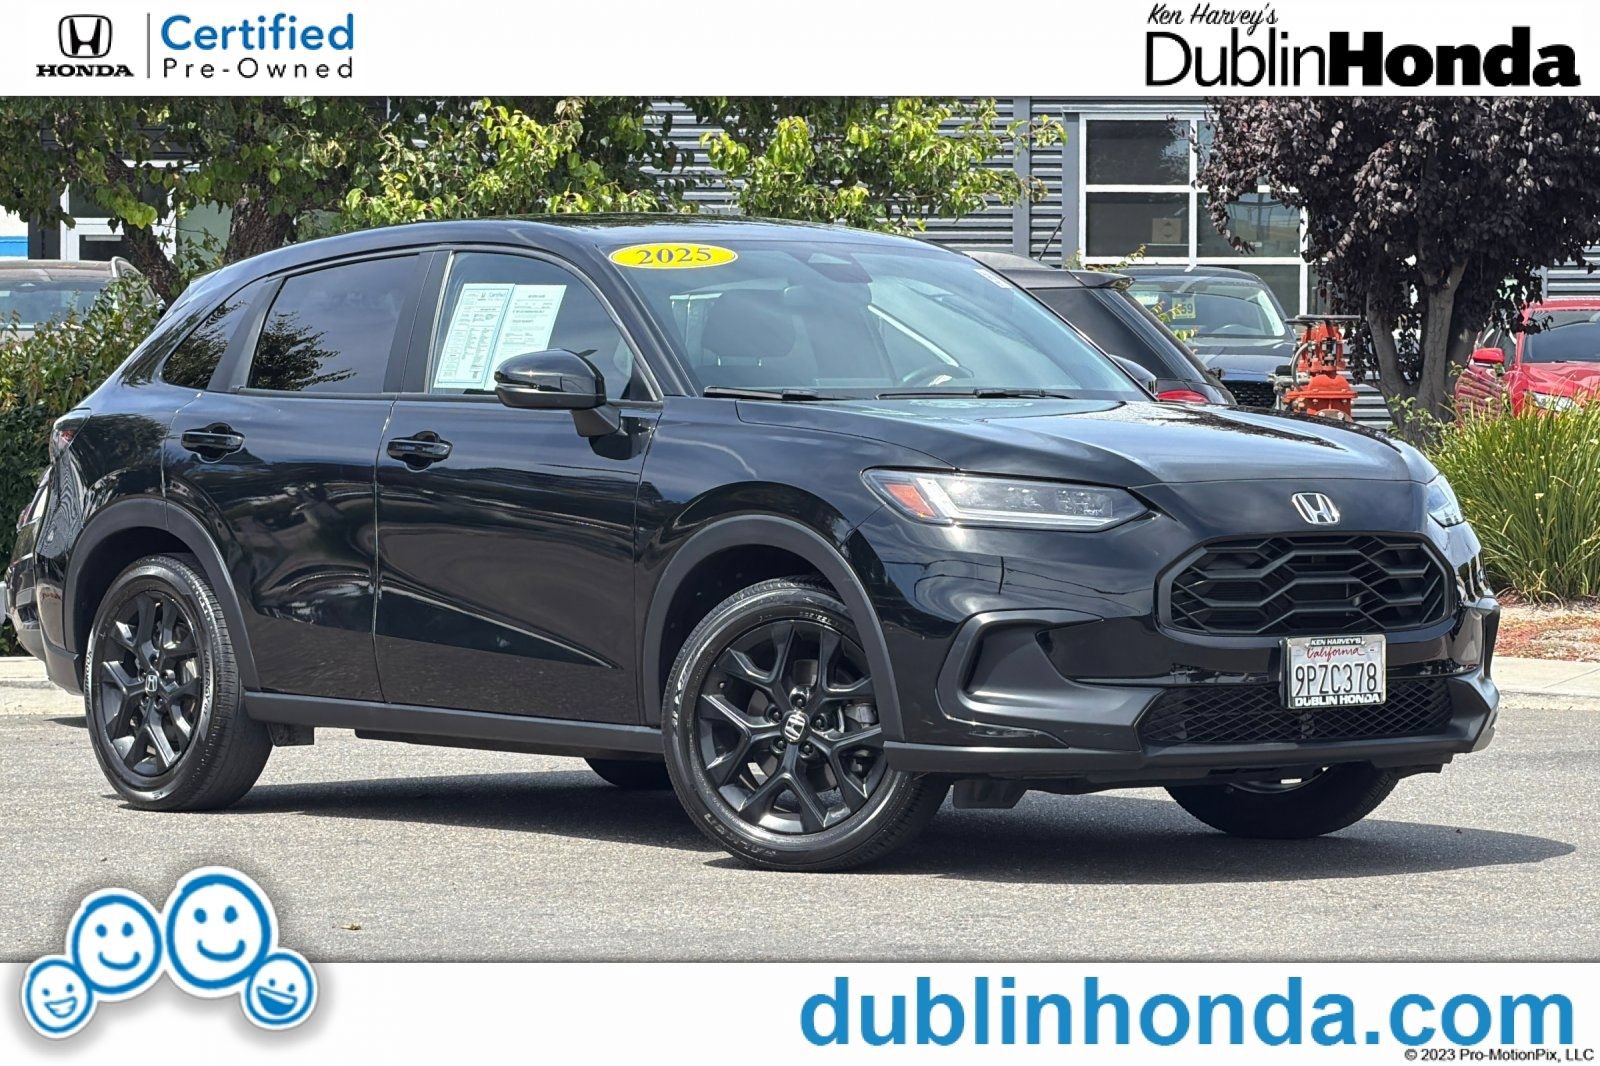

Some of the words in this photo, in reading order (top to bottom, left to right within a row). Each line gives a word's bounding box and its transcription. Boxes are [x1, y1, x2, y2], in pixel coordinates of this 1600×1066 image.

[635, 247, 712, 265] 2025
[1326, 637, 1361, 646] HARVEY'S
[1307, 646, 1366, 662] California
[1295, 662, 1378, 696] 9PZC378
[1294, 695, 1338, 707] DUBLIN
[1339, 693, 1381, 705] HONDA
